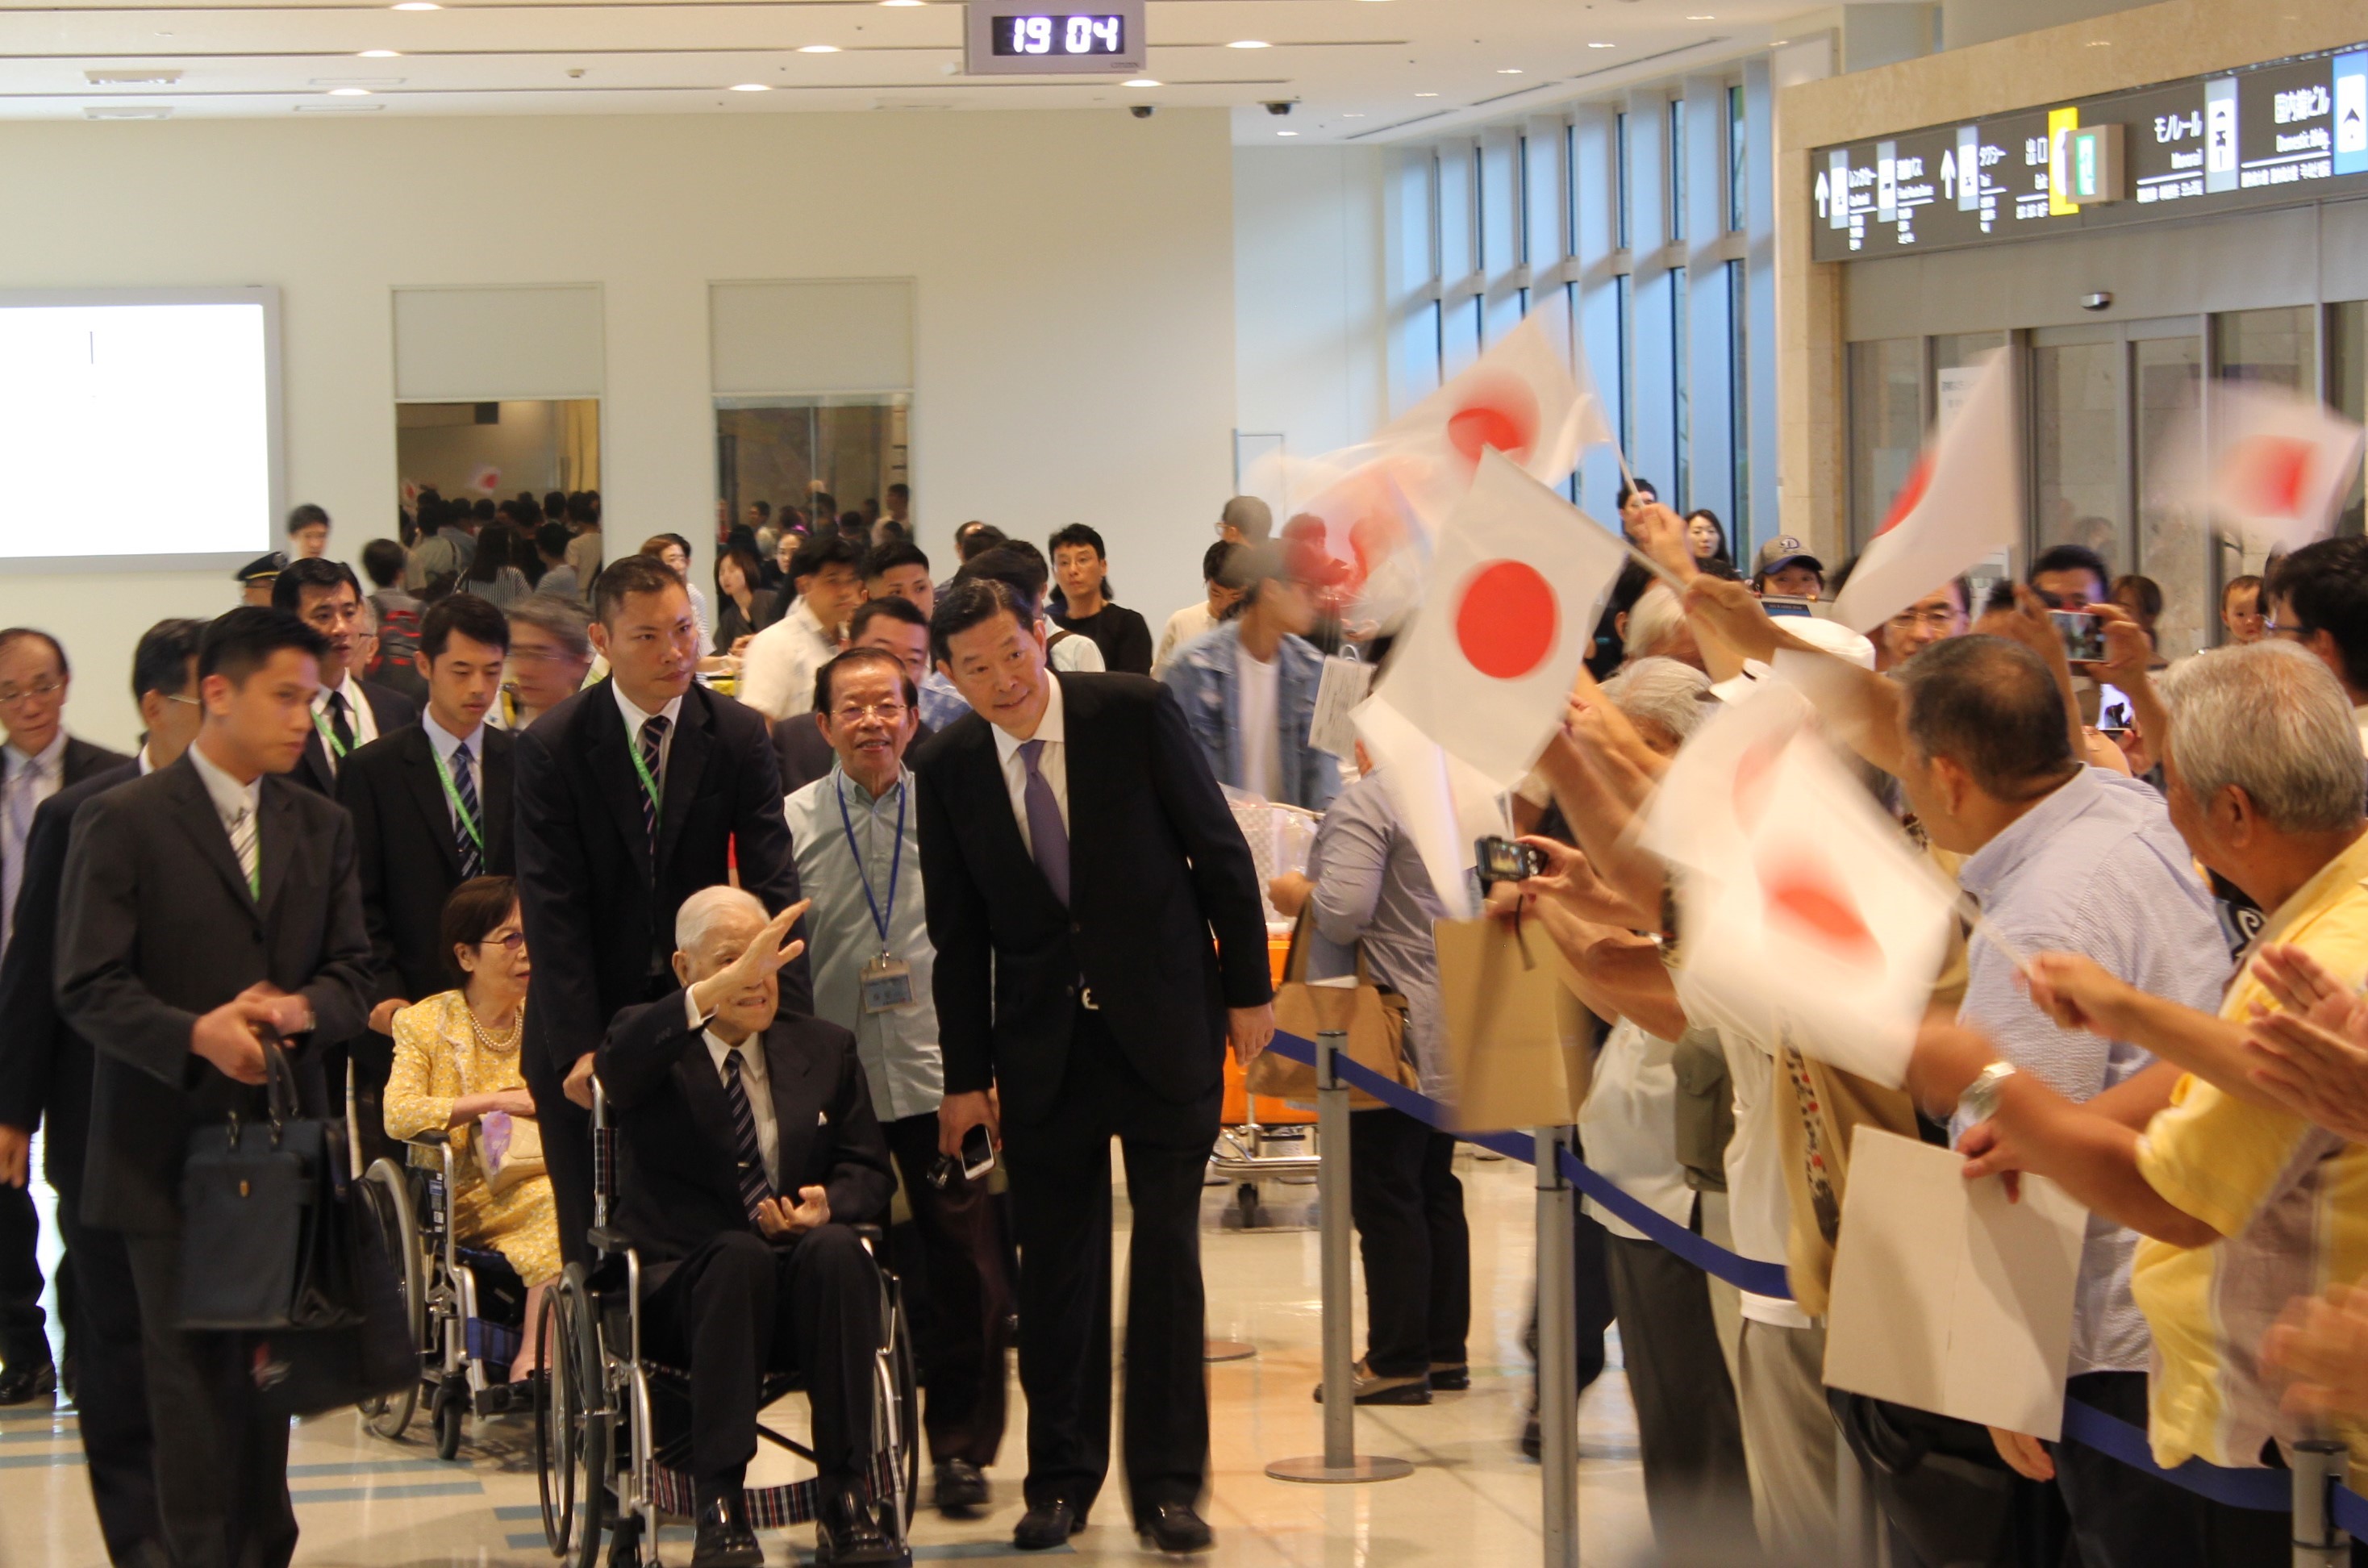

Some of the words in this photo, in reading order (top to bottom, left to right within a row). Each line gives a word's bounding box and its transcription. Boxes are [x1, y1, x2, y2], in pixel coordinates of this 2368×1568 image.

[1013, 17, 1052, 53] 19
[1065, 16, 1119, 53] 04
[2025, 137, 2049, 165] 出口
